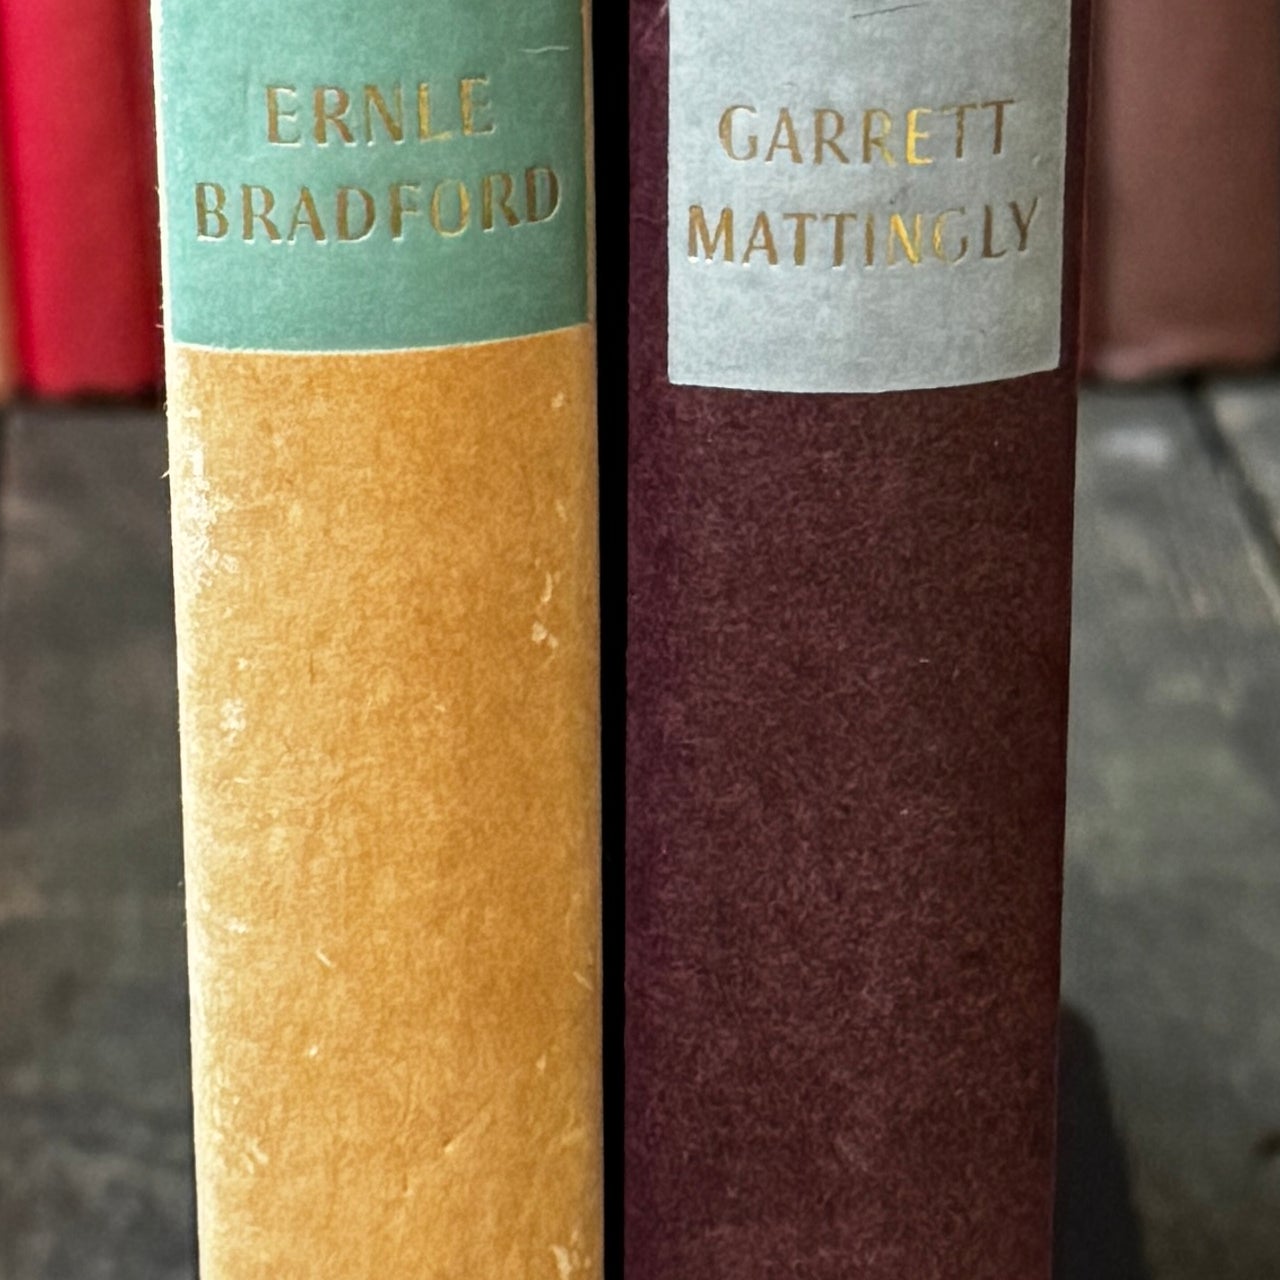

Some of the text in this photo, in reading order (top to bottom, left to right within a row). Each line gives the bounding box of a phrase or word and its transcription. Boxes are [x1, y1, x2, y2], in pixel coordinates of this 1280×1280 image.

[265, 73, 498, 148] ERNLE
[718, 99, 1016, 167] GARRETT
[194, 165, 562, 246] BRADFORD
[687, 196, 1039, 270] MATTINGLY
